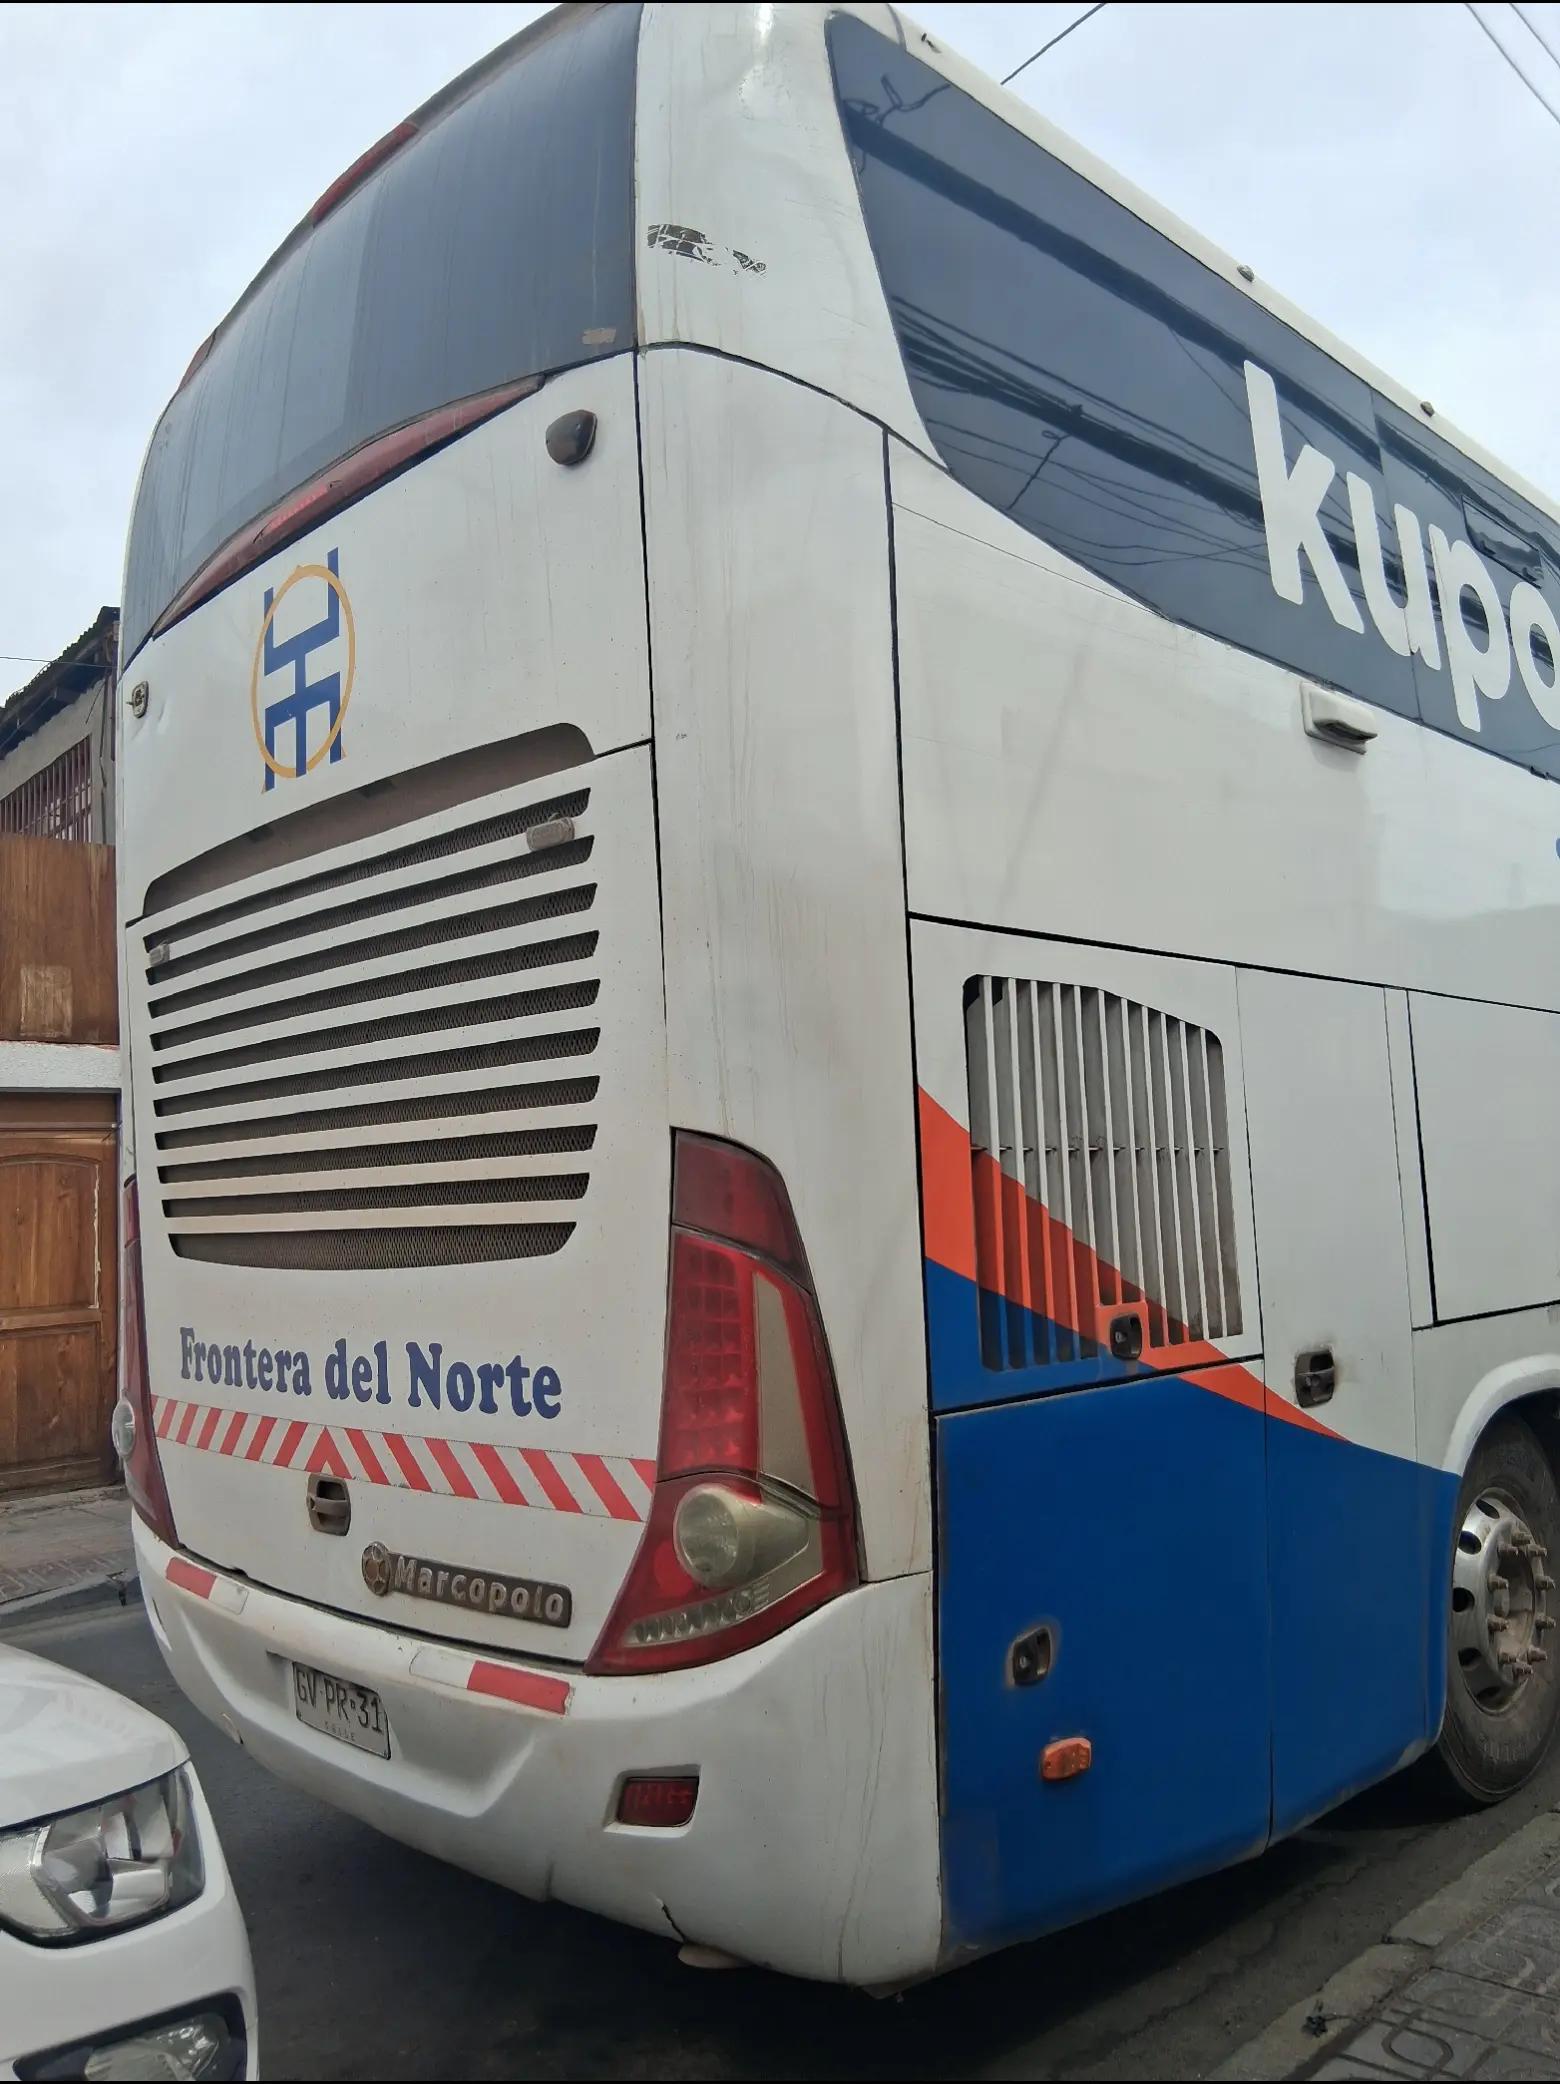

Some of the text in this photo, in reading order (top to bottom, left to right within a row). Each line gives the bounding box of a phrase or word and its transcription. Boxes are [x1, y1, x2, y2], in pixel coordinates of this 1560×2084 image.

[180, 1327, 562, 1419] Frontera del Norte
[395, 1555, 564, 1620] Marcopolo
